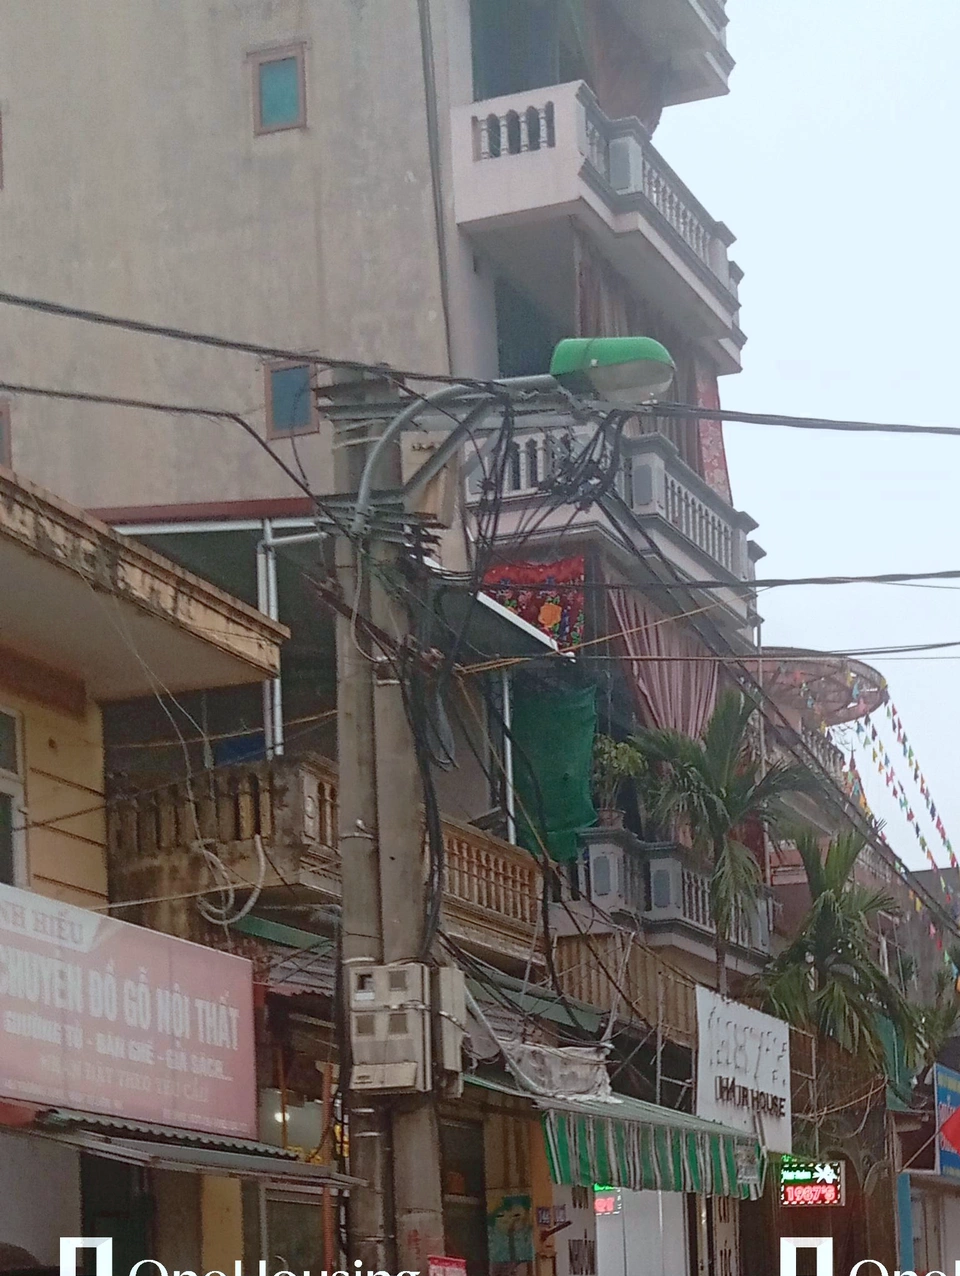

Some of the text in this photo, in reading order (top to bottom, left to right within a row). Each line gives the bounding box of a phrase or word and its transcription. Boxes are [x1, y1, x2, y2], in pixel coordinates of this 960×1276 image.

[89, 959, 118, 1022] ĐỒ
[124, 968, 152, 1030] GỖ
[157, 984, 190, 1048] NỘI
[195, 990, 240, 1050] THẤT
[750, 1089, 786, 1117] HOUSE
